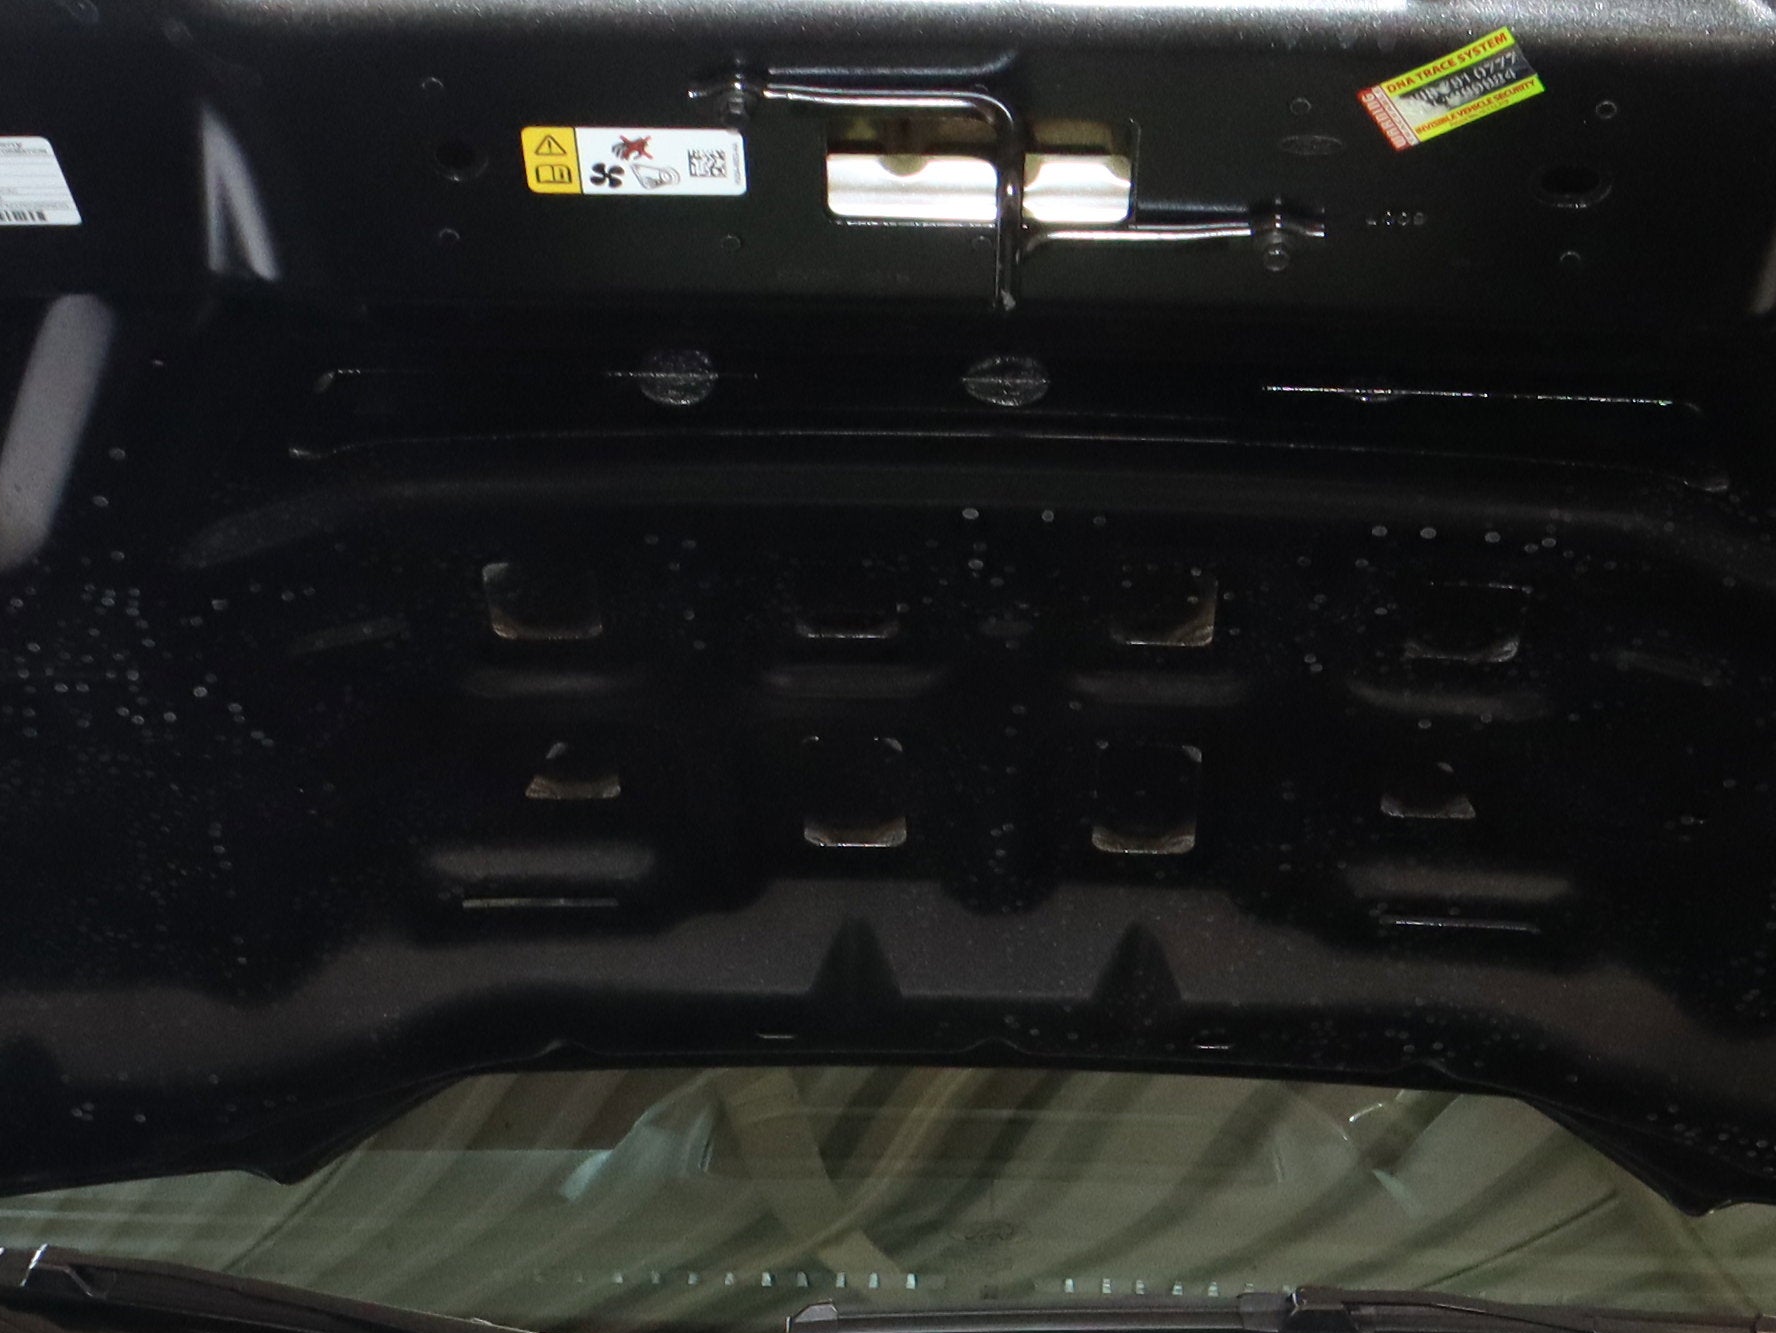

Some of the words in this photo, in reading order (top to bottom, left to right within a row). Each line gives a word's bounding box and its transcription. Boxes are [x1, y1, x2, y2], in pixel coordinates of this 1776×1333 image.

[1387, 76, 1415, 93] DNA
[1416, 57, 1457, 82] TRACE
[1457, 32, 1507, 63] SYSTEM
[1415, 111, 1457, 136] INVISIBLE
[1457, 98, 1493, 119] VEHICLE
[1493, 79, 1537, 105] SECURITY
